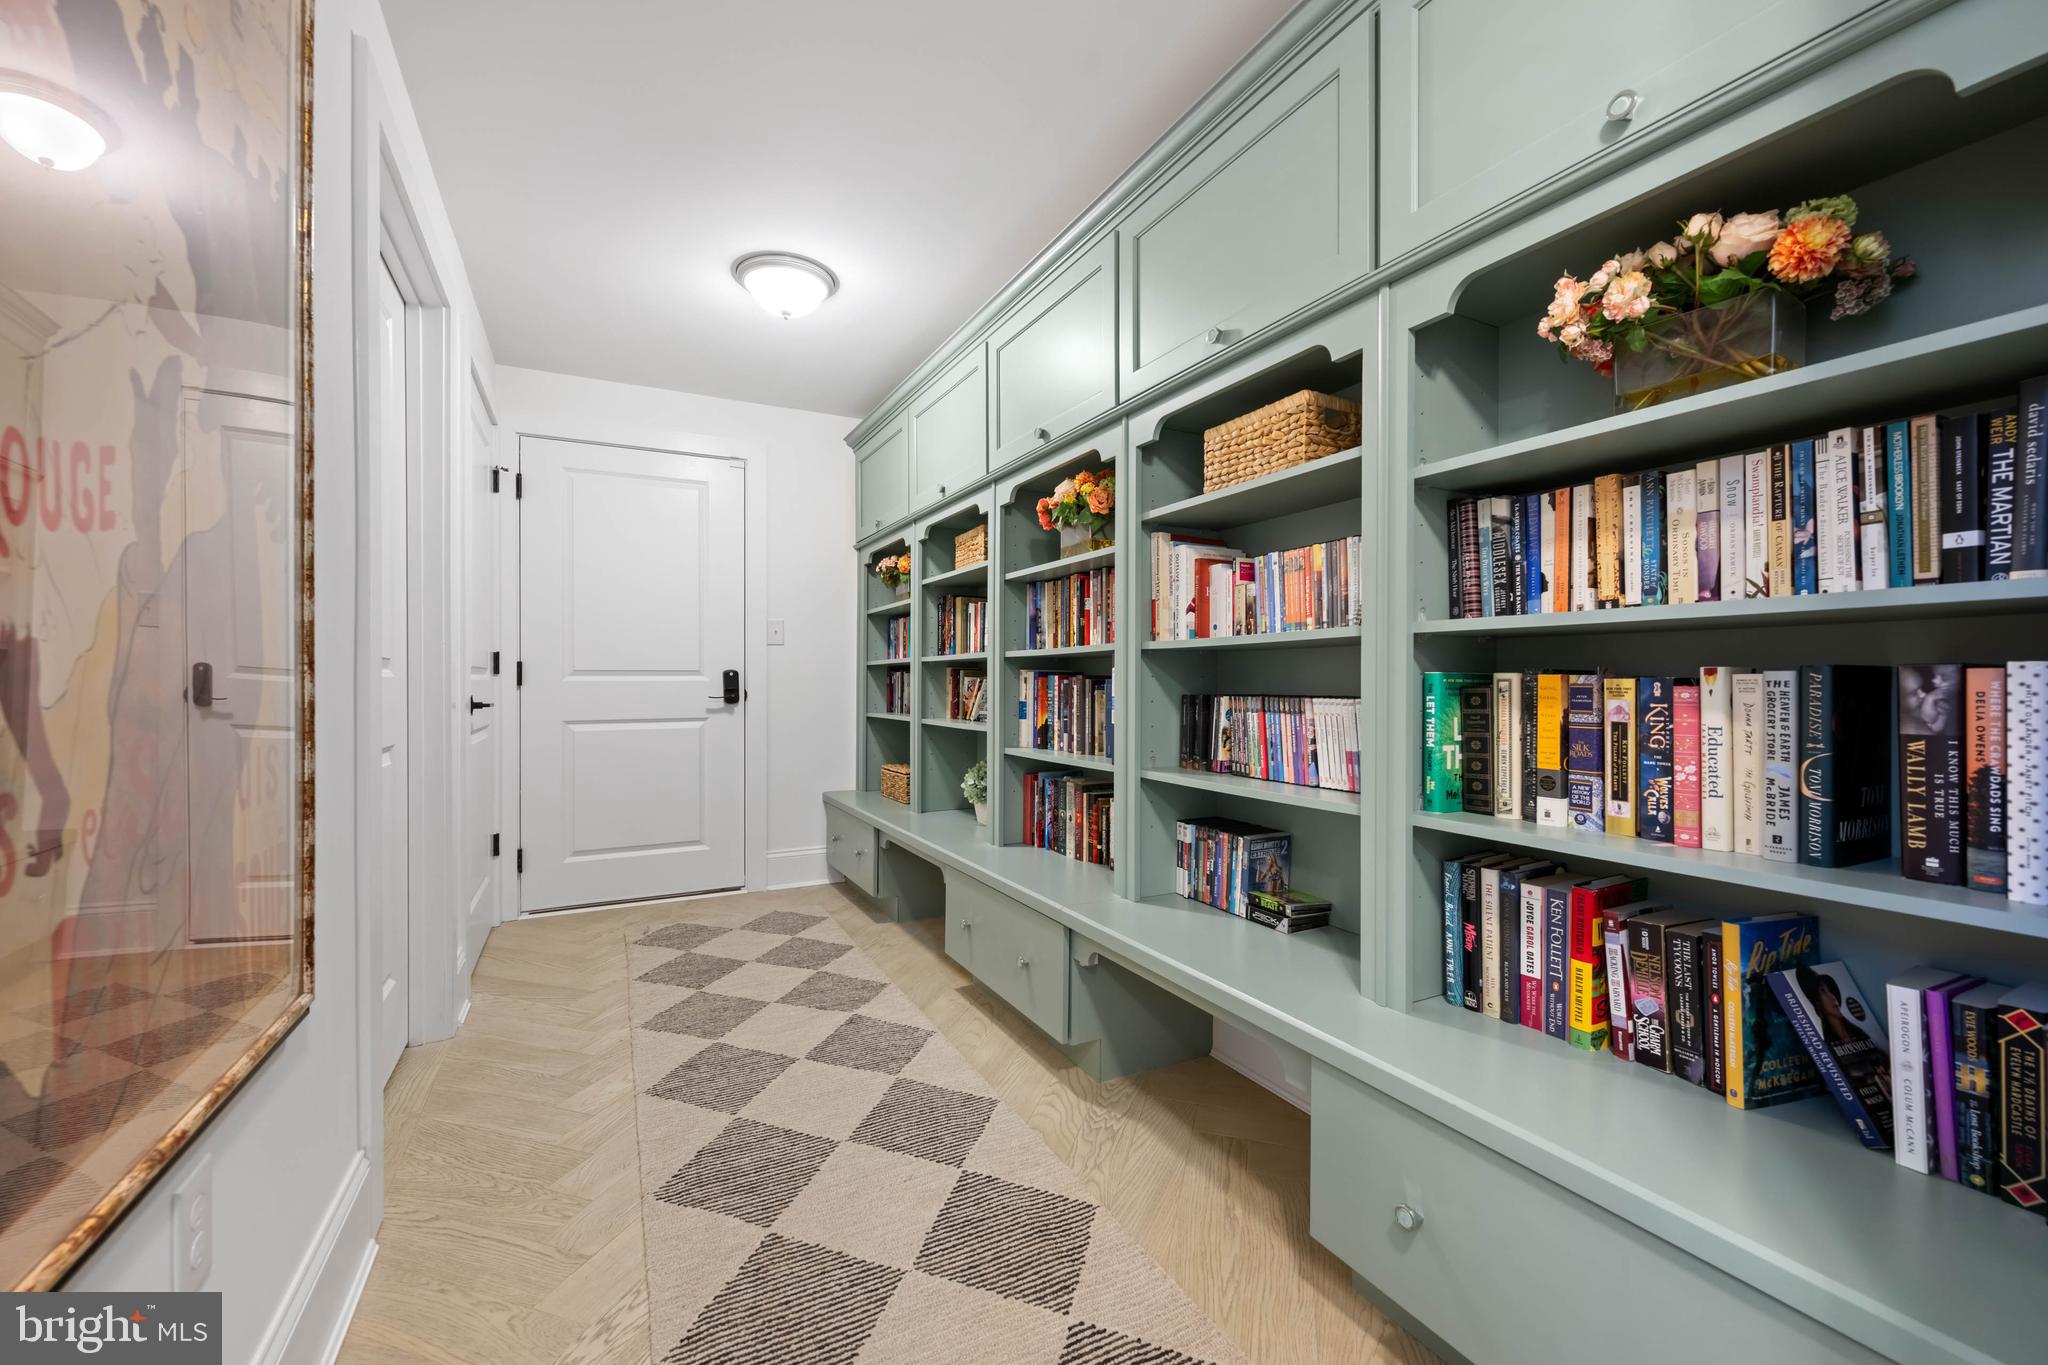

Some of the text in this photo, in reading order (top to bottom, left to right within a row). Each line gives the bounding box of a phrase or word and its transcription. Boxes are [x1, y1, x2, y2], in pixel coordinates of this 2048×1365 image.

[1990, 417, 2003, 445] WEIR
[2004, 414, 2017, 443] ANDY
[2024, 403, 2045, 486] david sedaris
[0, 424, 118, 536] OUGE
[1726, 479, 1740, 507] Snow
[1748, 460, 1764, 528] Swamplandia!
[1834, 455, 1848, 525] ALICE WALKER
[1646, 499, 1654, 549] PATCHETT
[1773, 462, 1786, 567] THE RAPTURE OF CANAAN
[1989, 448, 2014, 565] THE MARTIAN
[1492, 531, 1506, 584] MIDDLESEX
[1671, 519, 1680, 568] ORDINARY
[1681, 532, 1690, 578] SONGS IN
[1426, 695, 1435, 714] LET
[1766, 680, 1790, 688] THE
[1779, 690, 1790, 723] HEAVEN
[1808, 672, 1822, 739] PARADISE
[1426, 717, 1435, 747] THEM
[1645, 703, 1669, 749] KING
[1766, 690, 1776, 761] GROCERY STORE
[1780, 733, 1791, 762] EARTH
[1975, 691, 1986, 763] DELIA OWENS
[1706, 726, 1724, 800] Educated
[1948, 750, 1959, 783] KNOW
[1989, 680, 2002, 832] WHERE THE CRAWDADS SING
[1642, 789, 1658, 815] CALLA
[1658, 776, 1672, 810] WOLVES
[1766, 777, 1776, 827] McBRIDE
[1778, 785, 1790, 821] JAMES
[1808, 768, 1822, 859] TONI MORRISON
[1906, 739, 1927, 849] WALLY LAMB
[1933, 774, 1945, 818] IS TRUE
[1948, 789, 1959, 815] THIS
[1948, 820, 1960, 853] MUCH
[1466, 868, 1476, 901] STEPHEN
[1485, 883, 1493, 897] THE
[1485, 900, 1493, 925] SILENT
[1526, 901, 1534, 974] JOYCE CAROL OATES
[1549, 898, 1564, 982] KEN FOLLETT
[1746, 927, 1812, 984] Rip Tide
[1446, 958, 1455, 983] TYLER
[1648, 954, 1661, 1000] NELSON
[1673, 939, 1683, 987] TYCOONS
[1682, 940, 1693, 990] THE LAST
[1575, 967, 1583, 1024] HARLEM SHUFFLE
[1633, 1014, 1650, 1050] SCHOOL
[1650, 1025, 1664, 1056] CHARM
[1714, 1049, 1720, 1057] IN
[1784, 992, 1853, 1101] BRIDESHEAD REVISITED
[1791, 1020, 1826, 1074] EVELYN WAUGH
[1900, 1000, 1915, 1155] APEIROGON COLUM McCANN
[1966, 1010, 1983, 1170] EVIE WOODS Lost Bookshop
[2009, 1046, 2023, 1136] EVELYN HARDCASTLE
[2024, 1050, 2036, 1140] THE DEATHS OF
